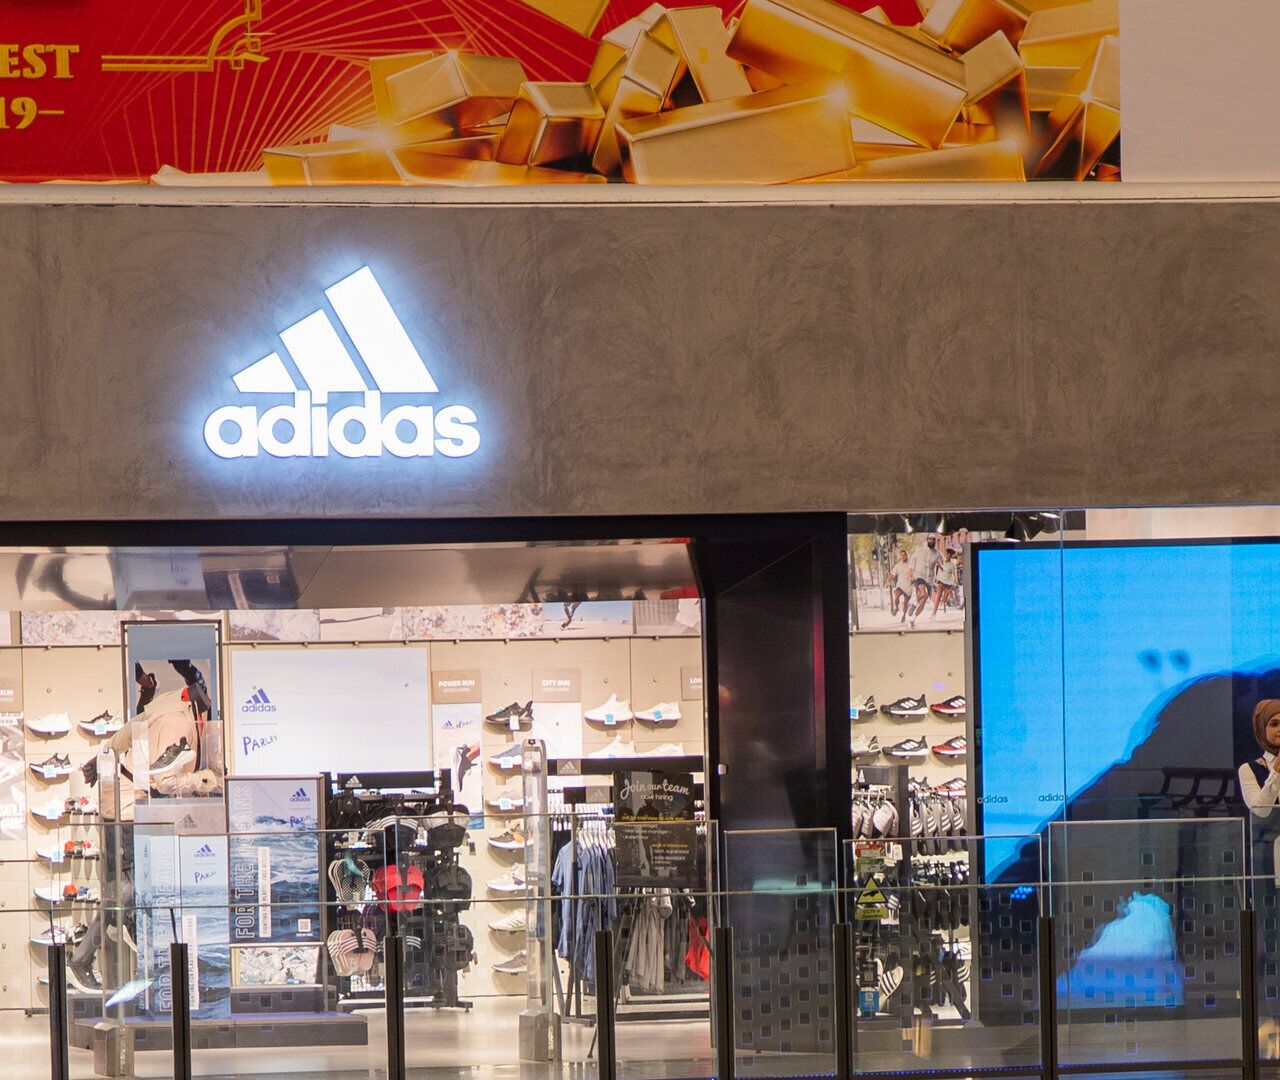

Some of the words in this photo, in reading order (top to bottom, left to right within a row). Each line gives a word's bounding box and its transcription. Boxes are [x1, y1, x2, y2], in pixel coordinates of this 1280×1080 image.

[203, 389, 481, 459] adidas
[241, 704, 277, 713] adidas
[620, 778, 646, 800] Join
[647, 783, 662, 792] our
[662, 778, 690, 795] team
[977, 795, 1009, 804] adidas
[234, 863, 255, 898] THE
[235, 905, 255, 939] FOR
